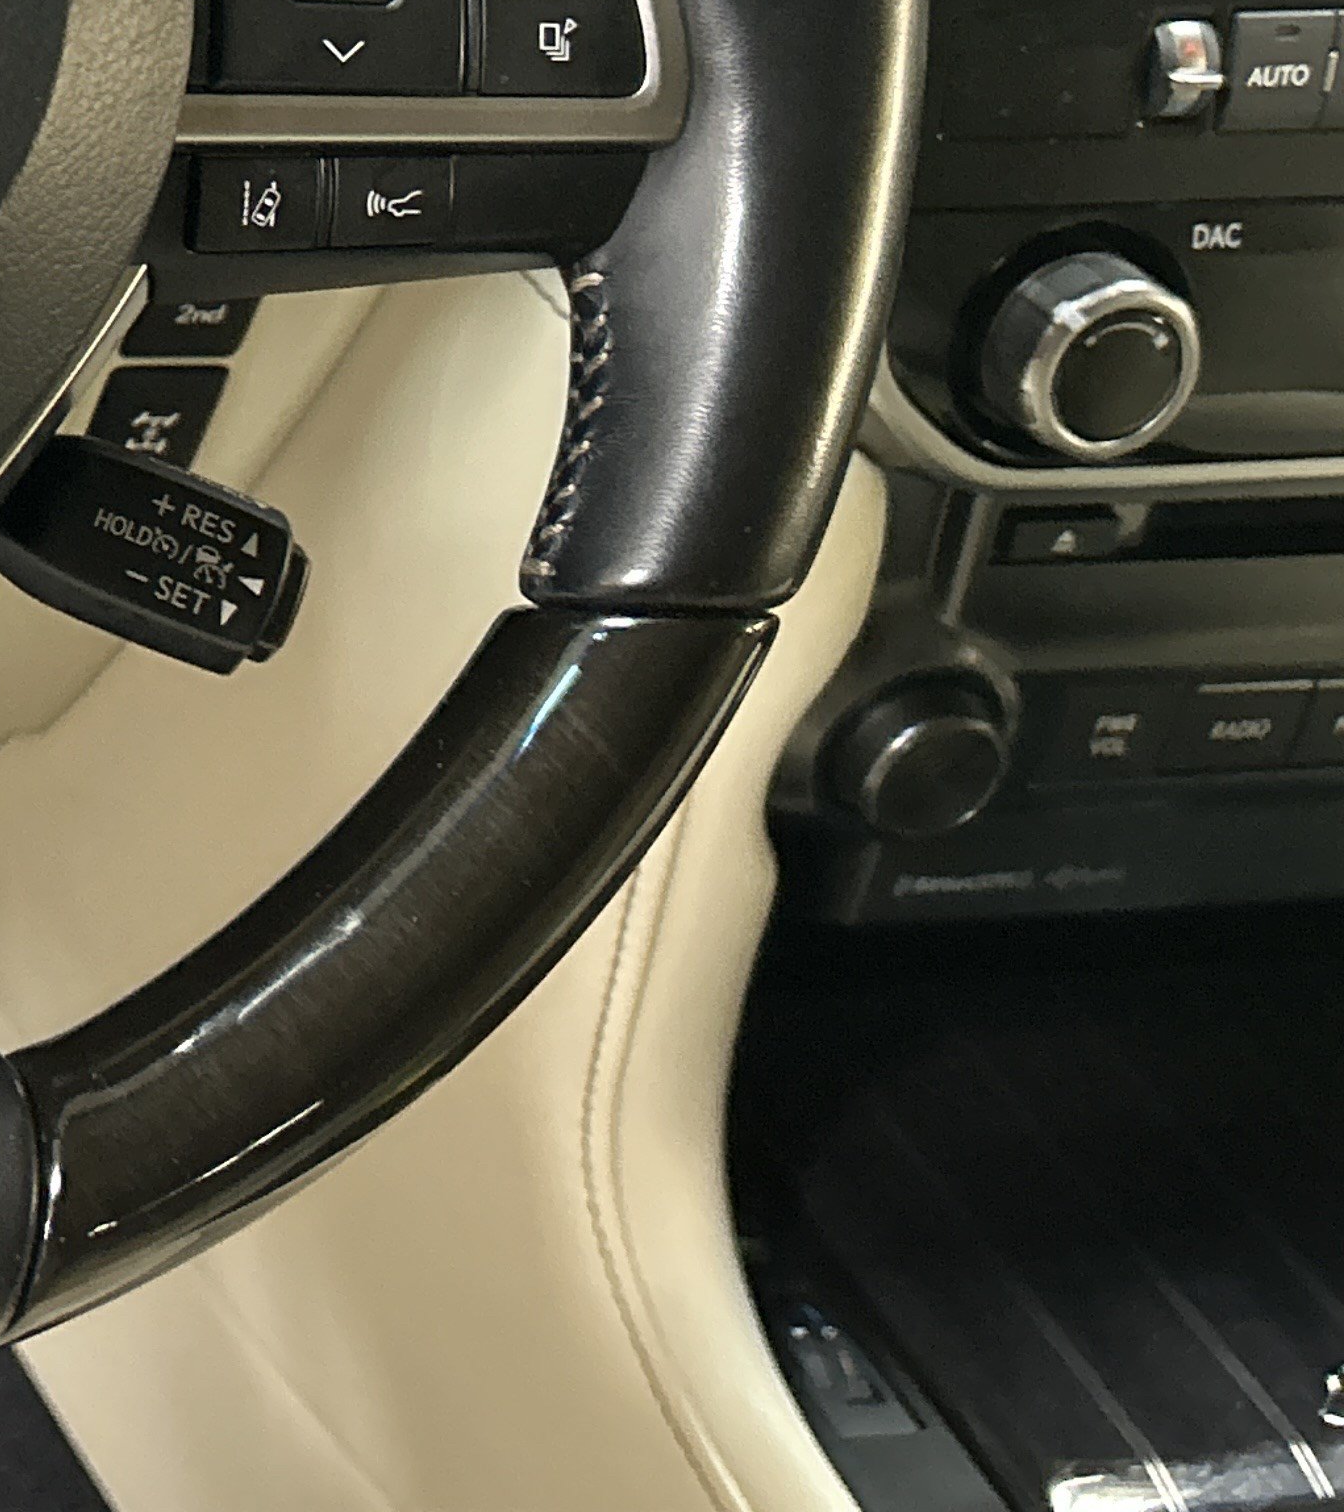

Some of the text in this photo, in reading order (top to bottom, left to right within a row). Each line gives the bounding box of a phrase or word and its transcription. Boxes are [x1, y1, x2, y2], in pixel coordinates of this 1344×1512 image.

[1246, 63, 1311, 87] AUTO
[1190, 222, 1244, 250] DAC
[93, 507, 154, 547] HOLD
[180, 502, 237, 544] RES
[153, 575, 212, 616] SET
